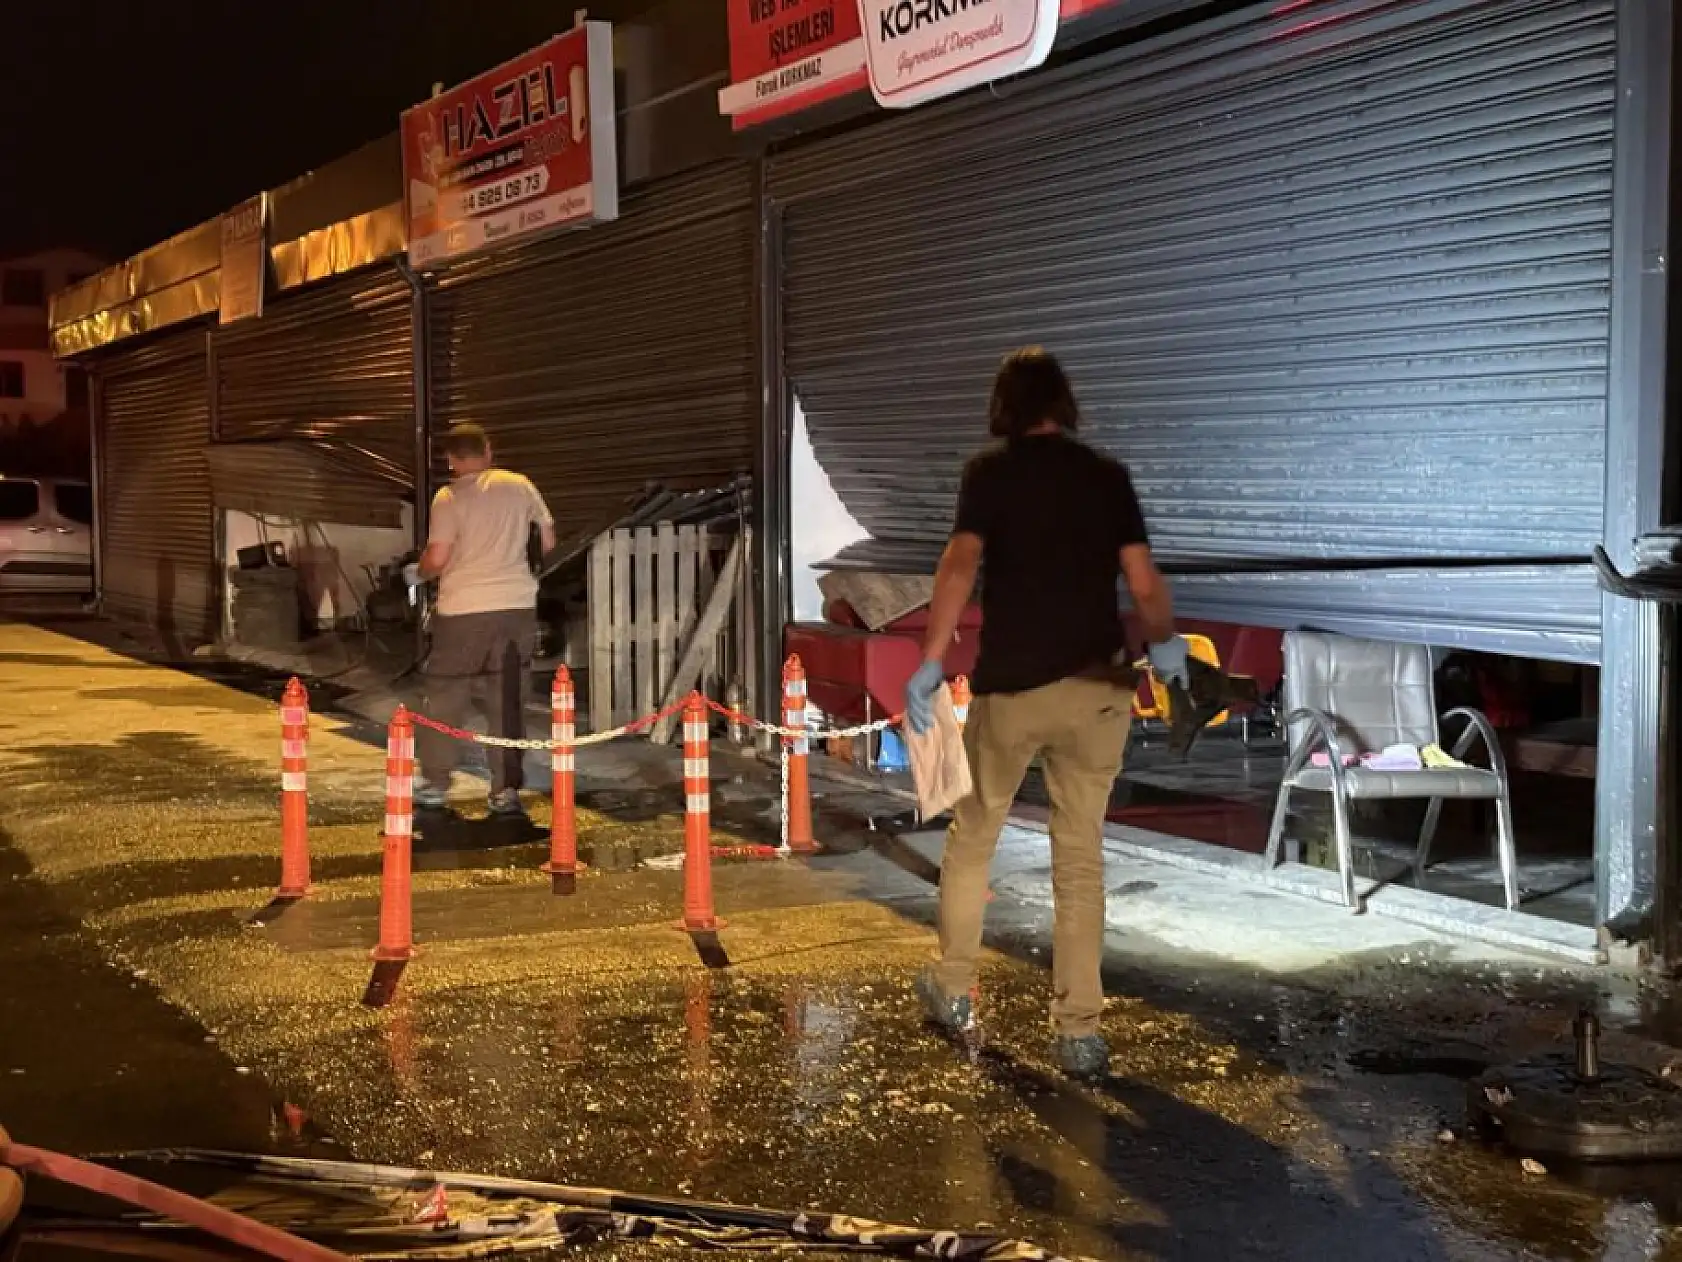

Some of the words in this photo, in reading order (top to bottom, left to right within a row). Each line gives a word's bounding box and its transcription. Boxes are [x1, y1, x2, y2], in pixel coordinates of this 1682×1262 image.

[780, 56, 822, 89] KORKMAZ
[442, 61, 568, 158] HAZEL
[524, 171, 540, 193] 73
